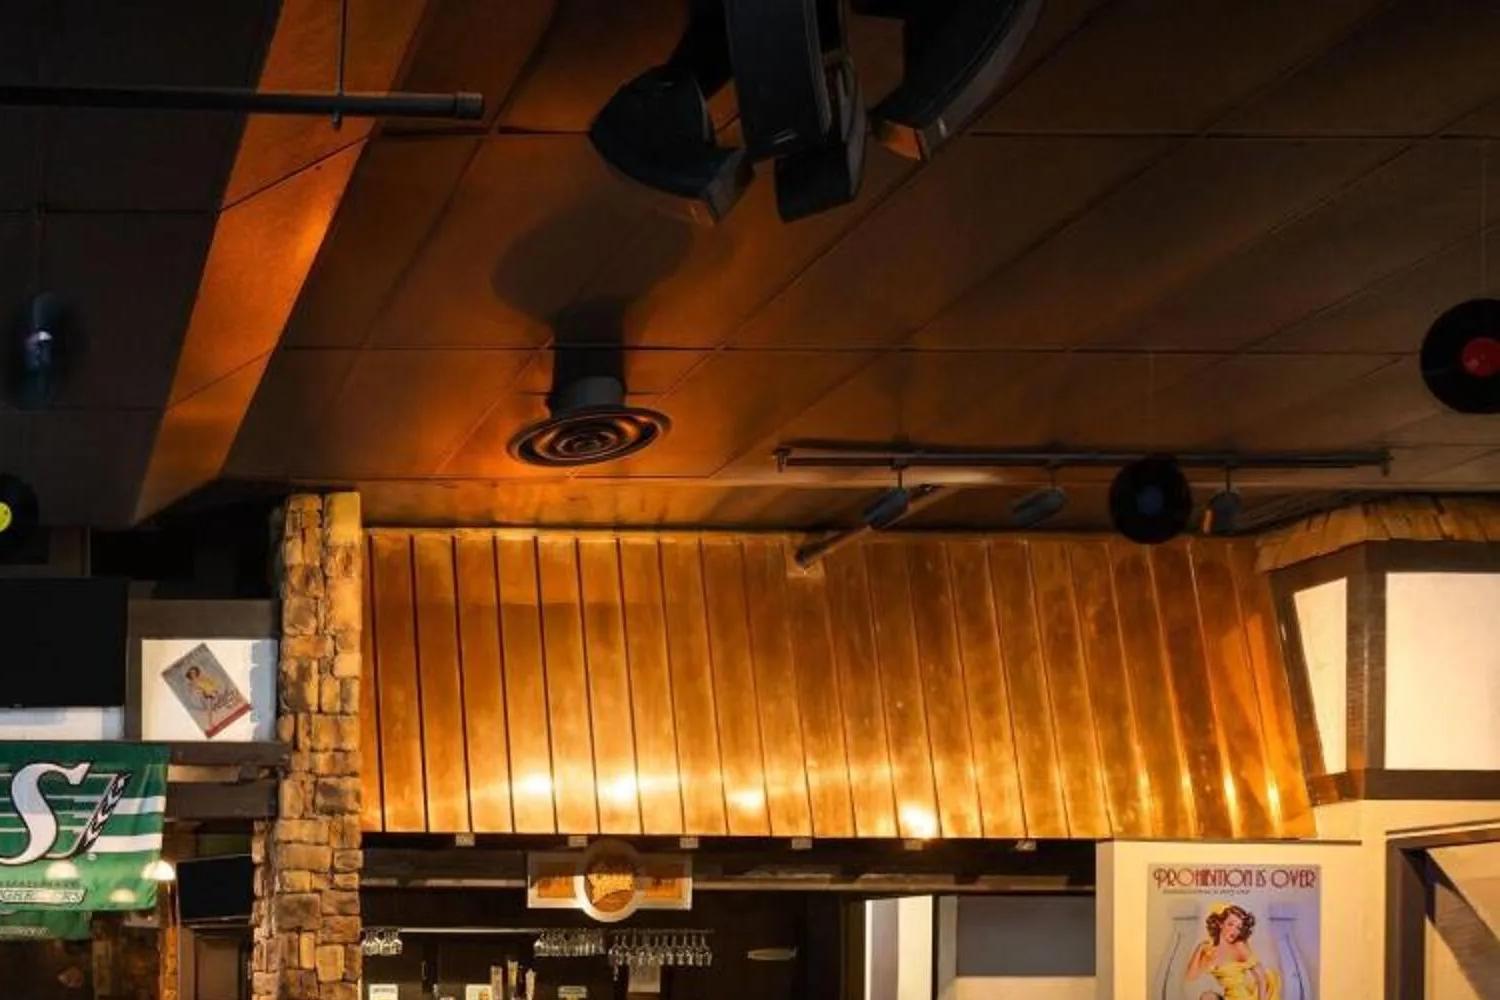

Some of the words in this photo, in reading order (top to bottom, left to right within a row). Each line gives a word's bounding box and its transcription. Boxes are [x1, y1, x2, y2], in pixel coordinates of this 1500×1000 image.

[1153, 868, 1253, 889] PROHIBITION
[1255, 868, 1267, 888] IS
[1270, 868, 1317, 889] OVER
